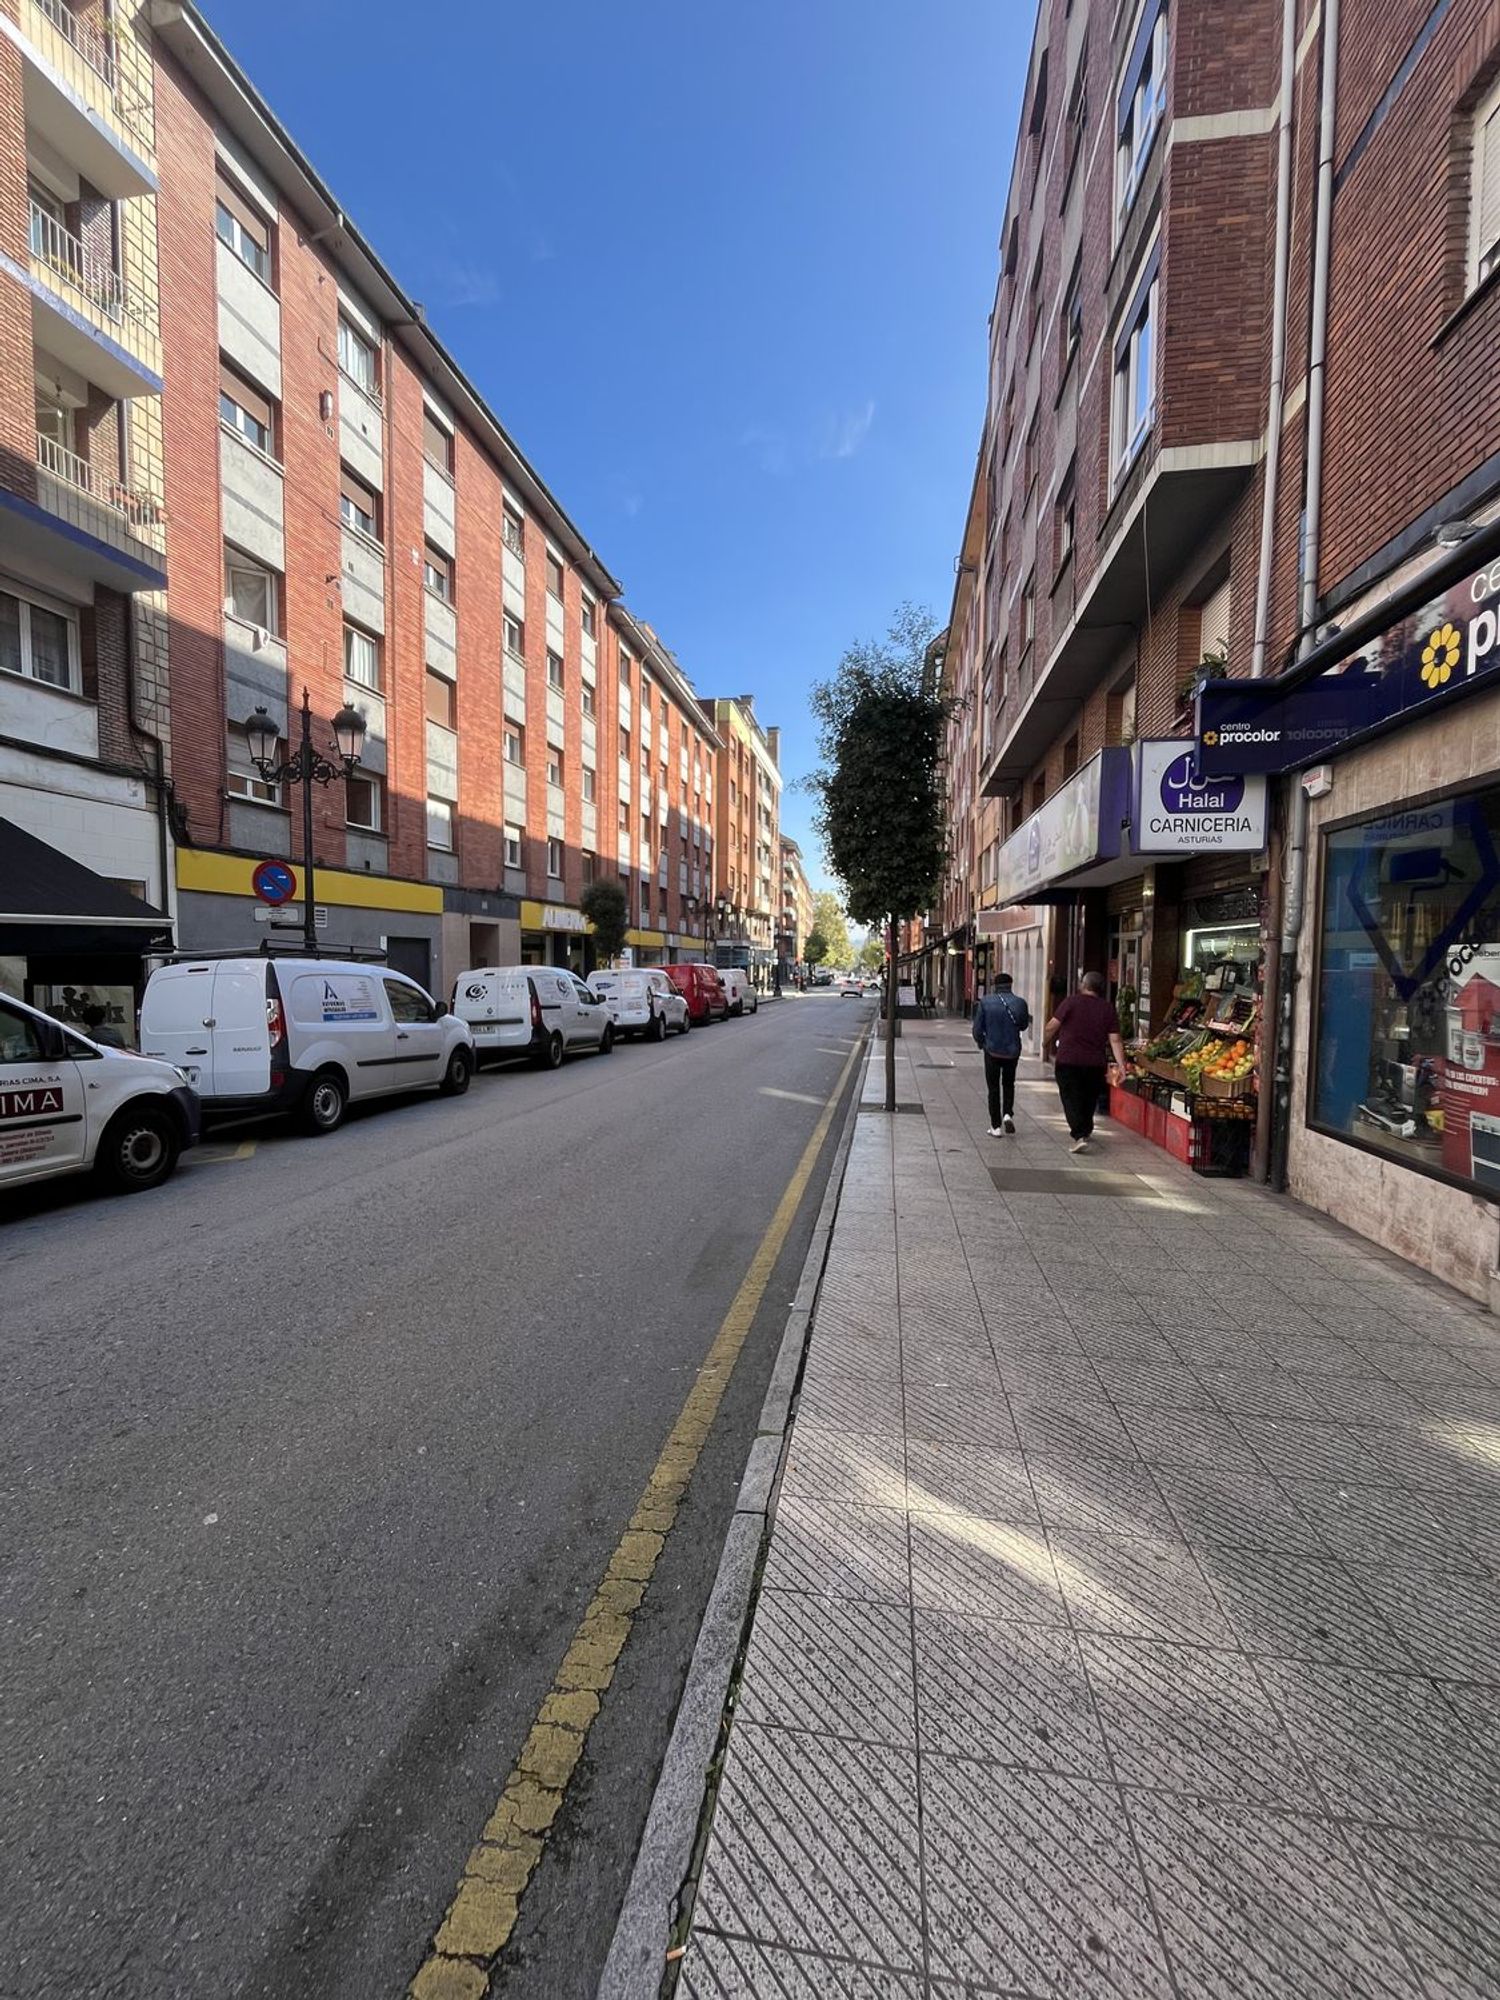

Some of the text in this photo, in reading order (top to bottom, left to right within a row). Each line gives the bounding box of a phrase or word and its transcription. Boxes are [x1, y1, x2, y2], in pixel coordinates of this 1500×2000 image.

[1220, 722, 1251, 731] centro
[1220, 729, 1281, 746] procolor
[1178, 792, 1225, 809] Halal
[1149, 817, 1252, 833] CARNICERIA
[1177, 836, 1223, 844] ASTURIAS
[22, 1076, 46, 1084] CIMA,
